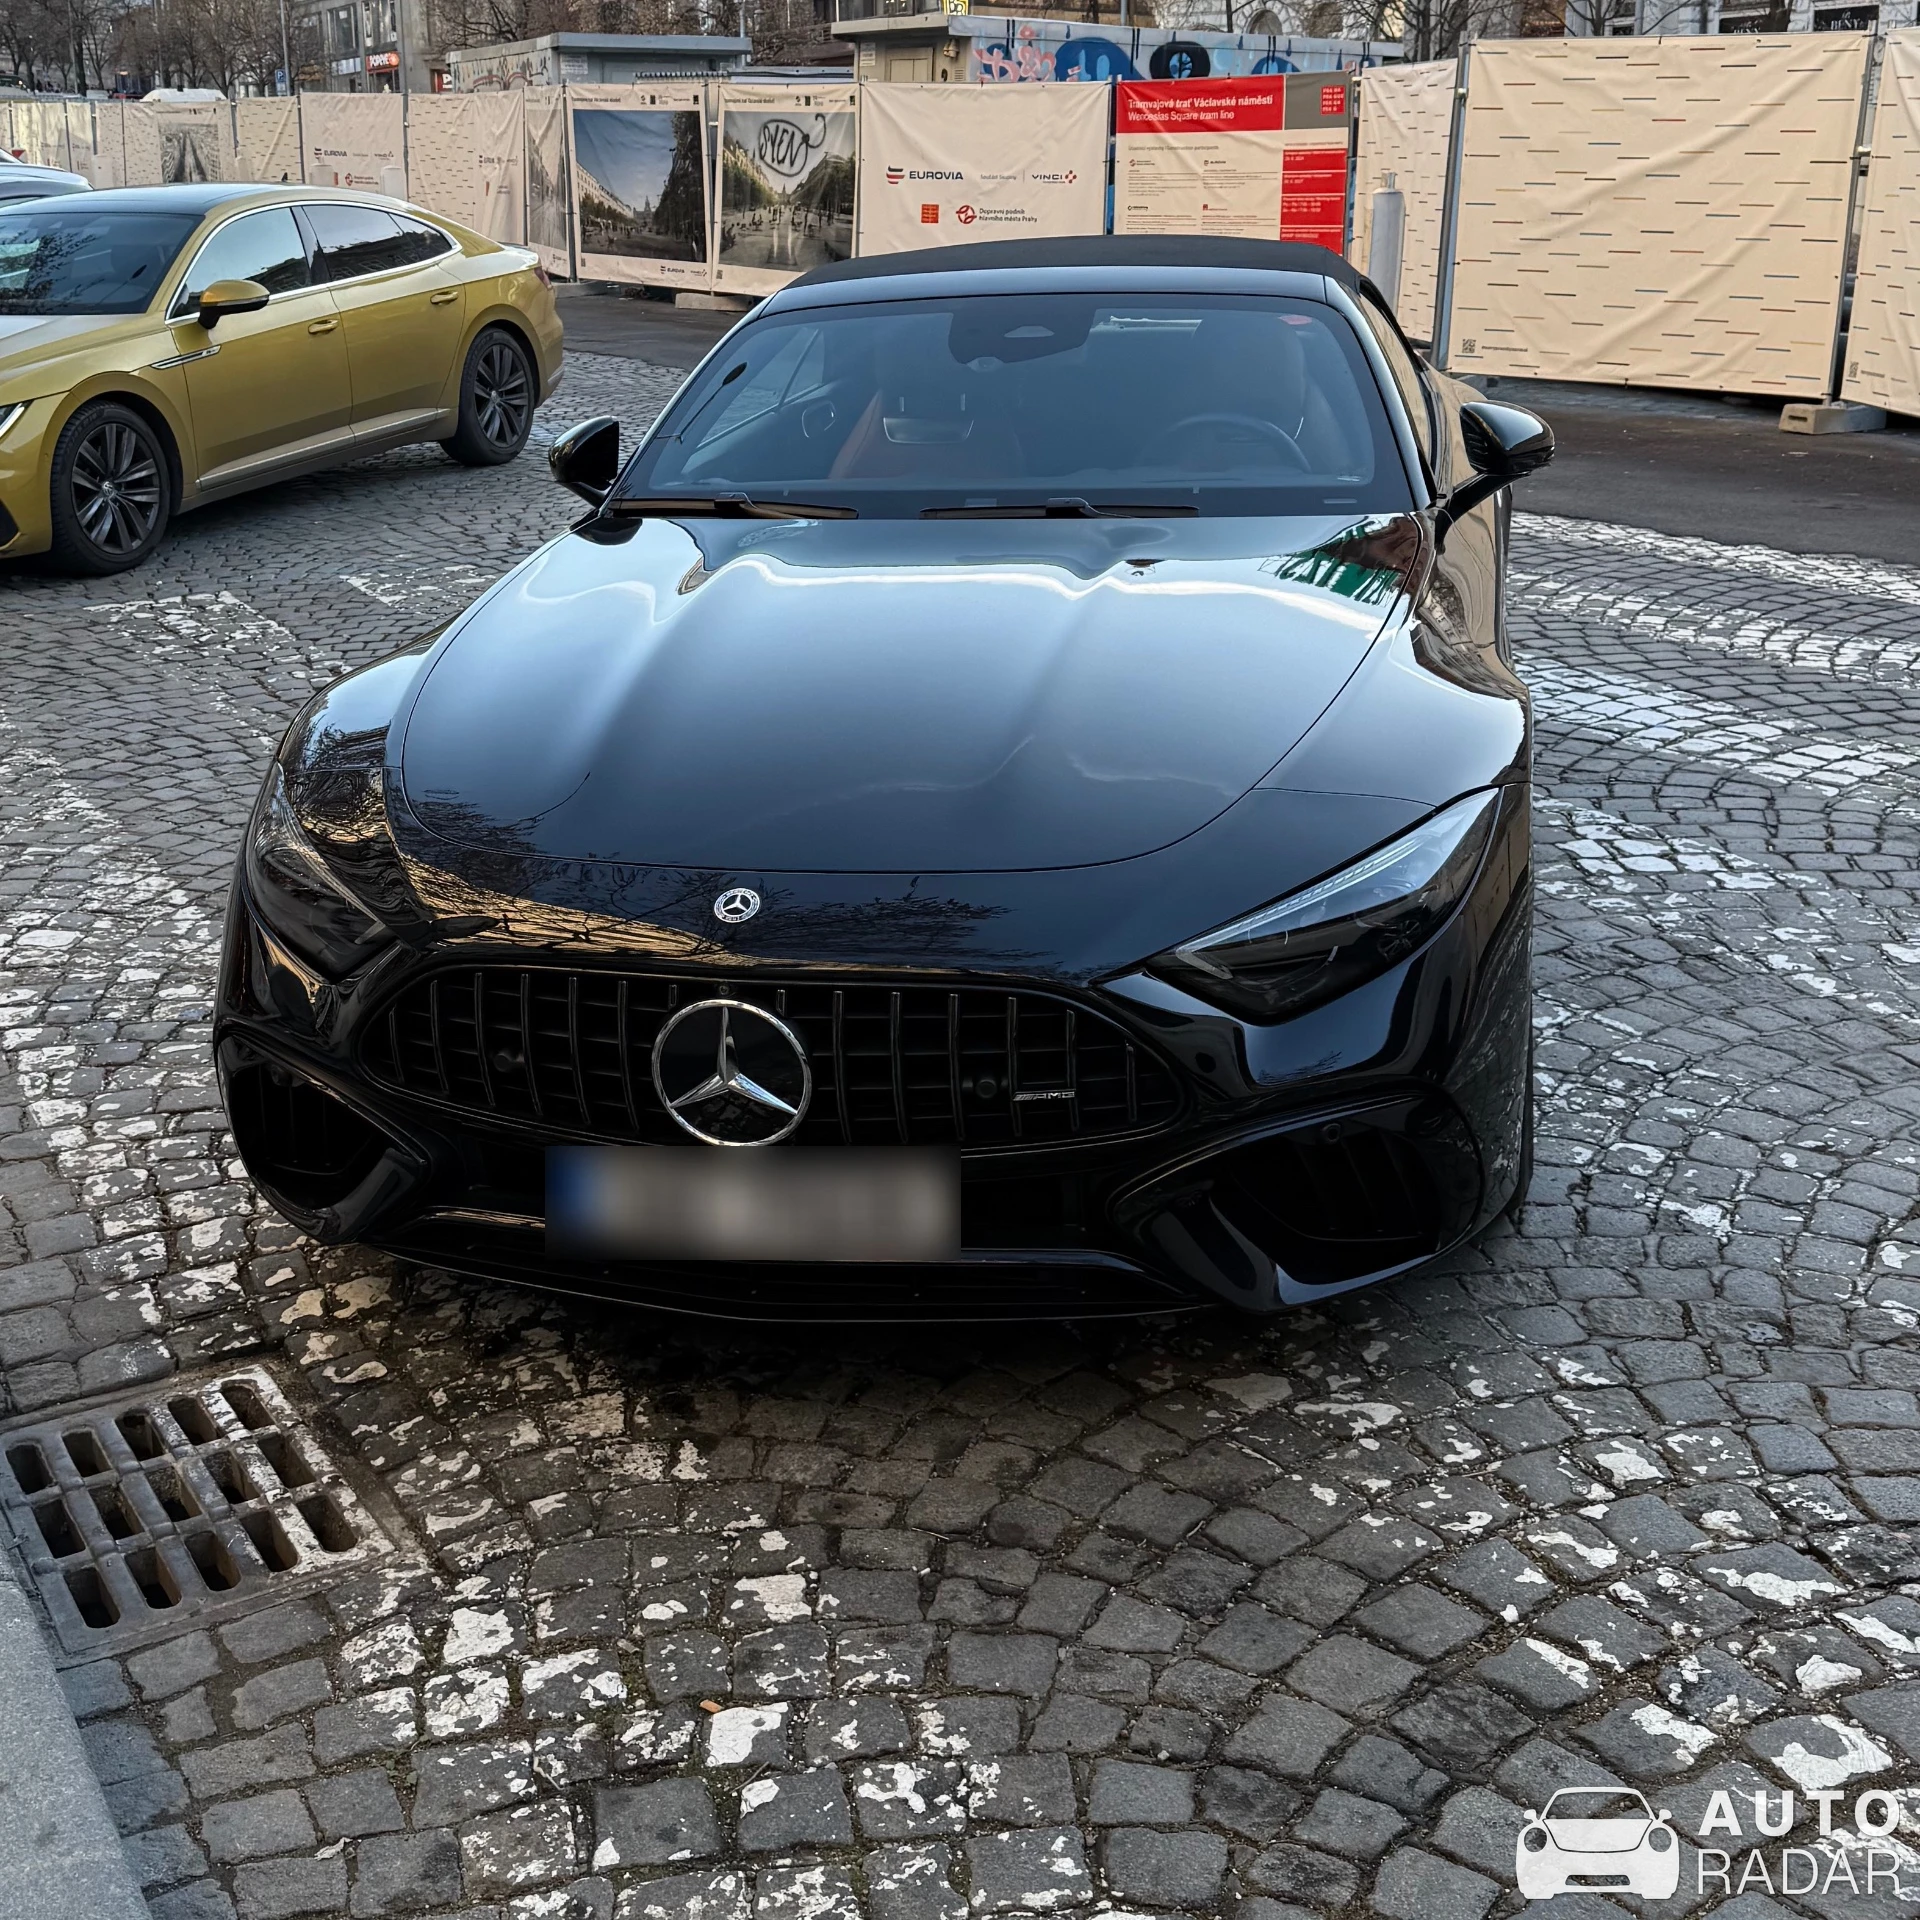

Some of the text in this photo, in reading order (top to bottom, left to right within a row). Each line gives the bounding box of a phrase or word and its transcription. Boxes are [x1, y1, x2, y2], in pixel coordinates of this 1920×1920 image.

[1193, 96, 1237, 107] Václavské
[1238, 94, 1273, 106] náměstí
[909, 170, 964, 180] EUROVIA
